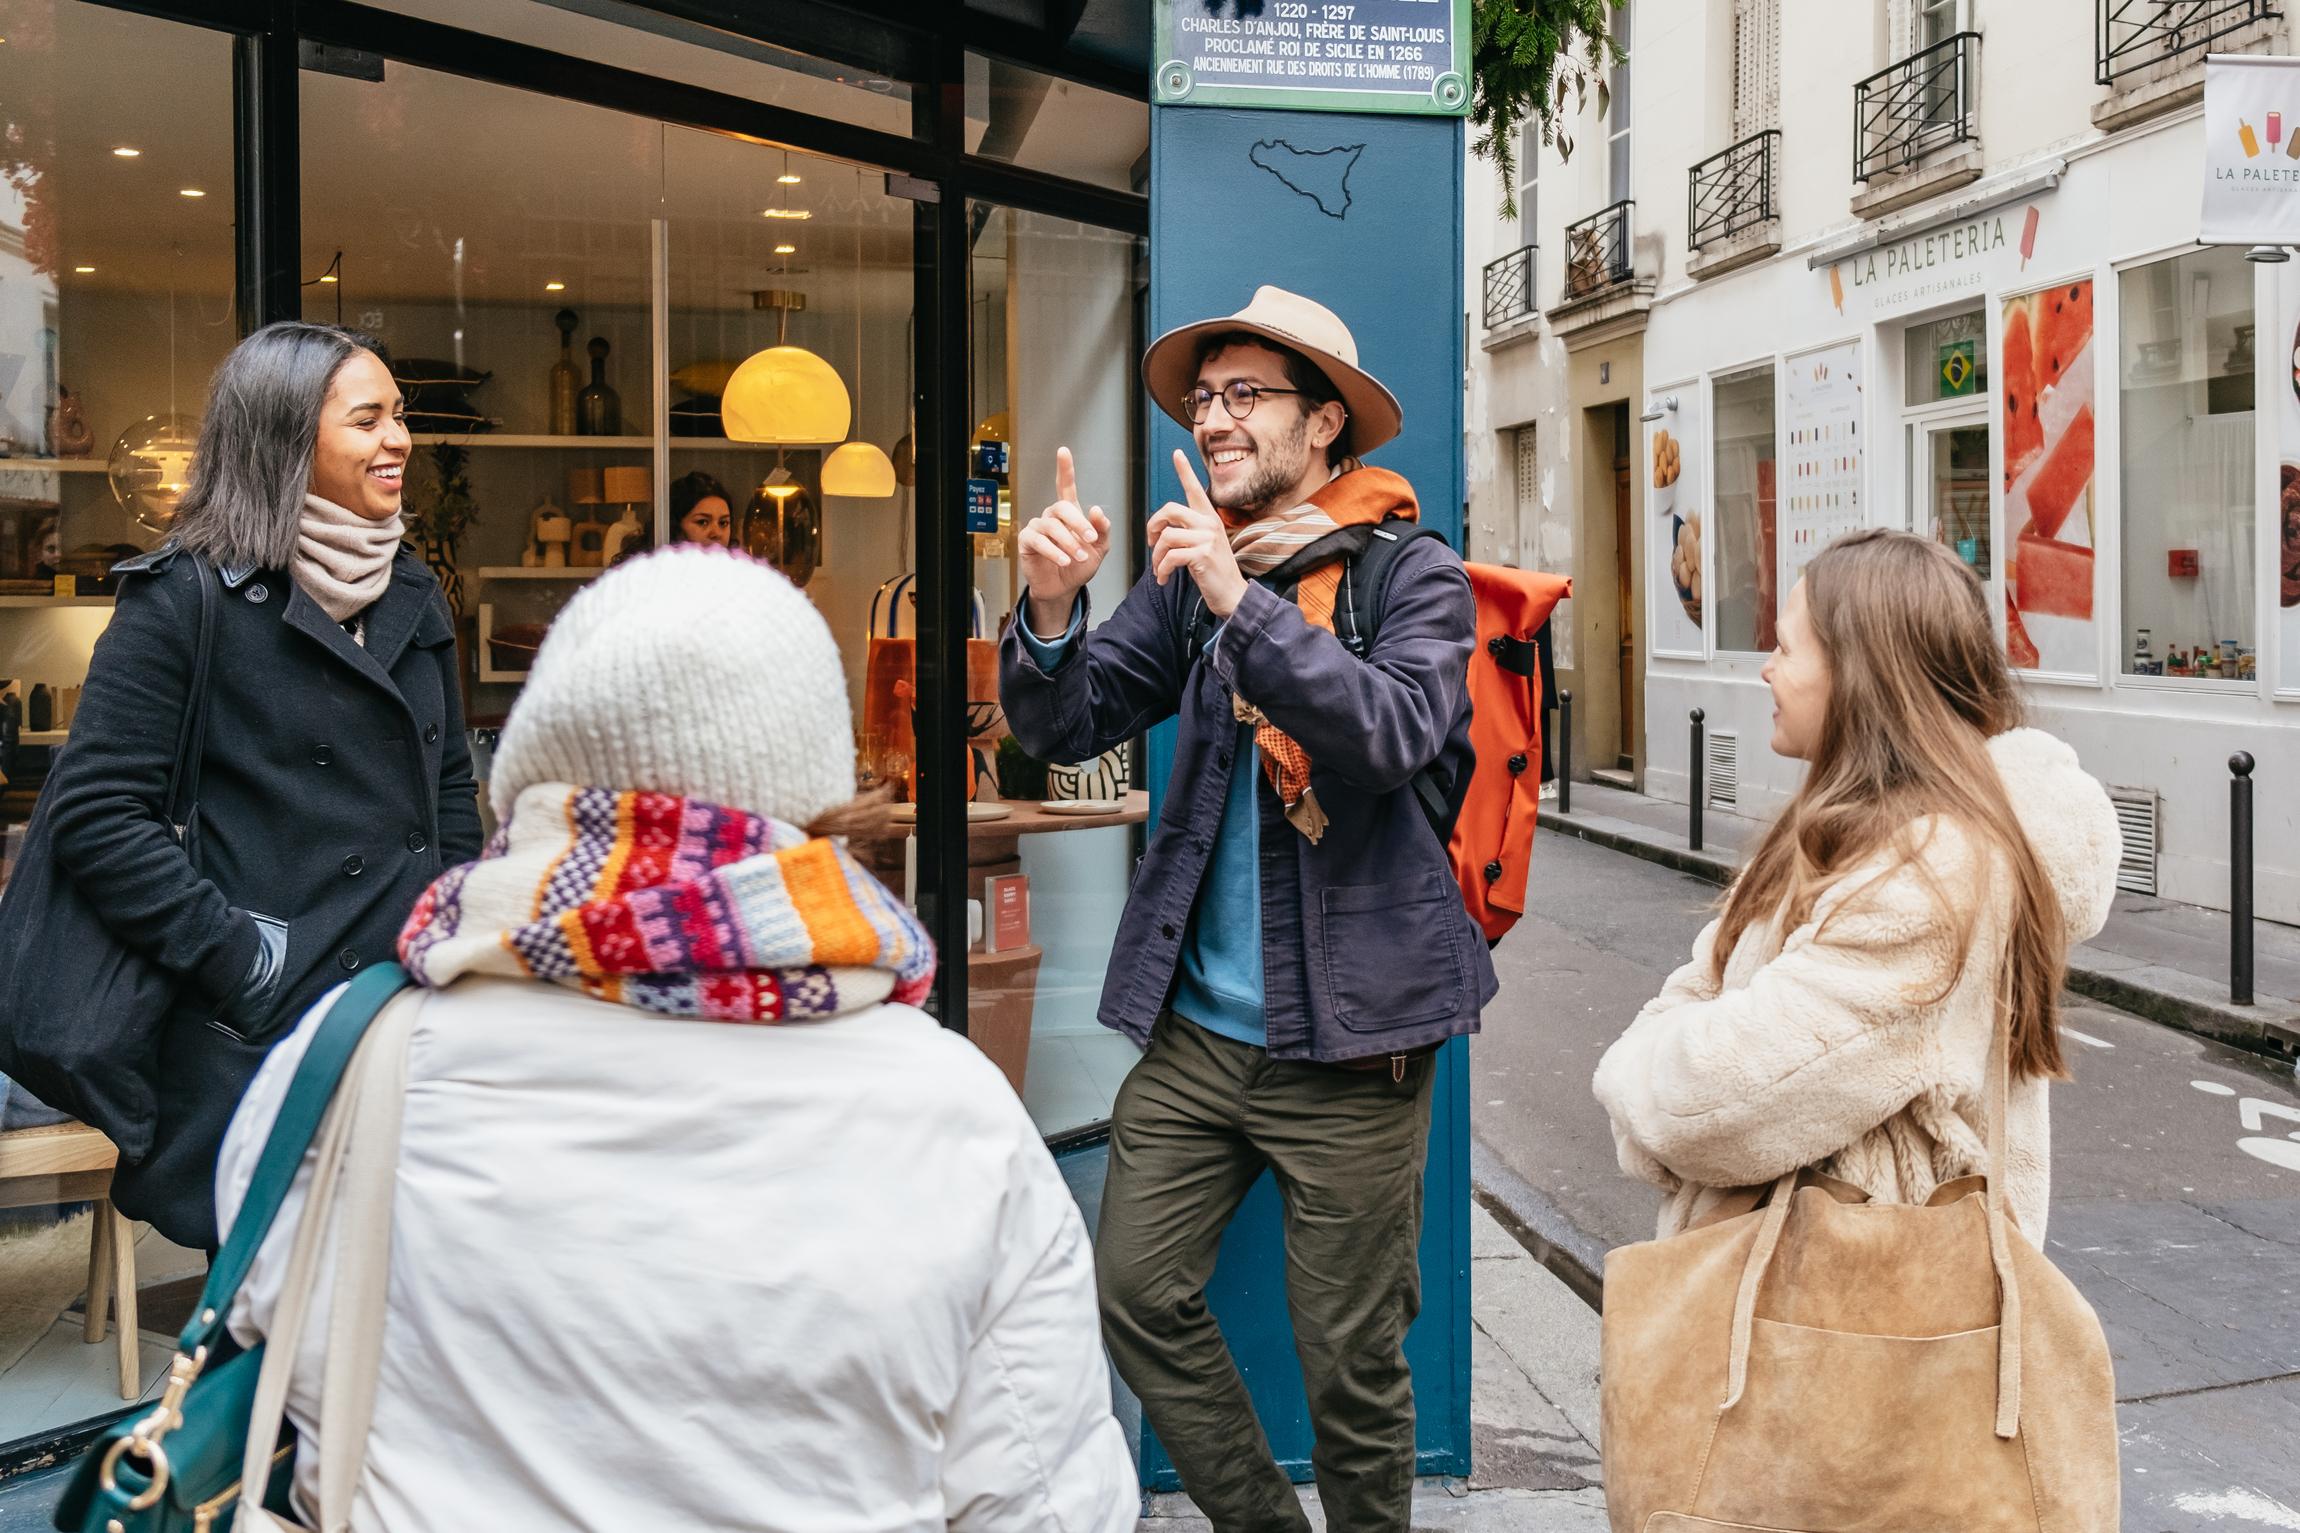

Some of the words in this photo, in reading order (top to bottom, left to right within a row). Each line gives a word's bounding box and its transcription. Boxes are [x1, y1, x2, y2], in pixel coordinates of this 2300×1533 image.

[1274, 3, 1307, 18] 1220
[1321, 4, 1355, 20] 1297
[1181, 17, 1240, 34] CHARLES
[1245, 20, 1302, 39] D'ANJOU,
[1306, 21, 1345, 39] FRÈRE
[1349, 25, 1366, 40] DE
[1370, 26, 1445, 43] SAINT-LOUIS
[1205, 37, 1275, 55] PROCLAMÉ
[1279, 41, 1300, 56] ROI
[1304, 42, 1321, 57] DE
[1325, 43, 1364, 59] SICILE
[1367, 45, 1384, 60] EN
[1388, 46, 1422, 61] 1266
[1193, 56, 1264, 74] ANCIENNEMENT
[1266, 59, 1285, 74] RUE
[1287, 60, 1306, 76] DES
[1308, 61, 1342, 77] DROITS
[1344, 63, 1357, 77] DE
[1359, 63, 1400, 79] L'HOMME
[1403, 65, 1434, 81] (1789)
[2216, 167, 2234, 180] LA
[2243, 168, 2300, 182] PALETE
[1854, 255, 1877, 286] LA
[1887, 217, 2005, 278] PALETERIA
[1874, 292, 1908, 308] GLACES
[1913, 271, 1982, 297] ARTISANALES
